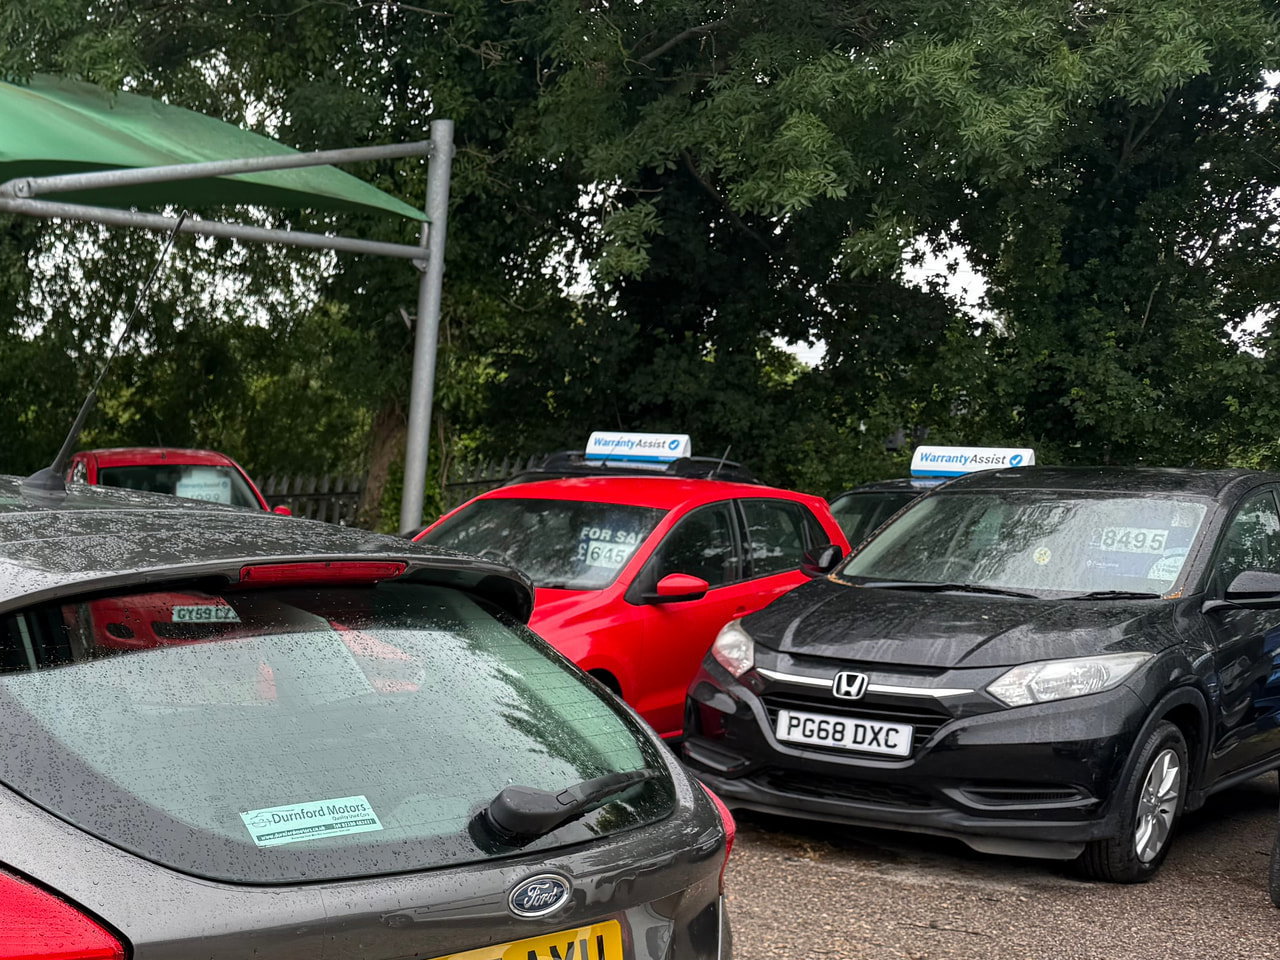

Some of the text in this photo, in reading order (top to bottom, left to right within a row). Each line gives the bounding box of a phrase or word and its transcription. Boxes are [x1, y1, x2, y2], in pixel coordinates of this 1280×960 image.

[581, 527, 612, 541] FOR
[787, 716, 899, 749] PG68 DXC
[271, 803, 367, 825] Durnford Motors
[524, 883, 558, 909] Ford
